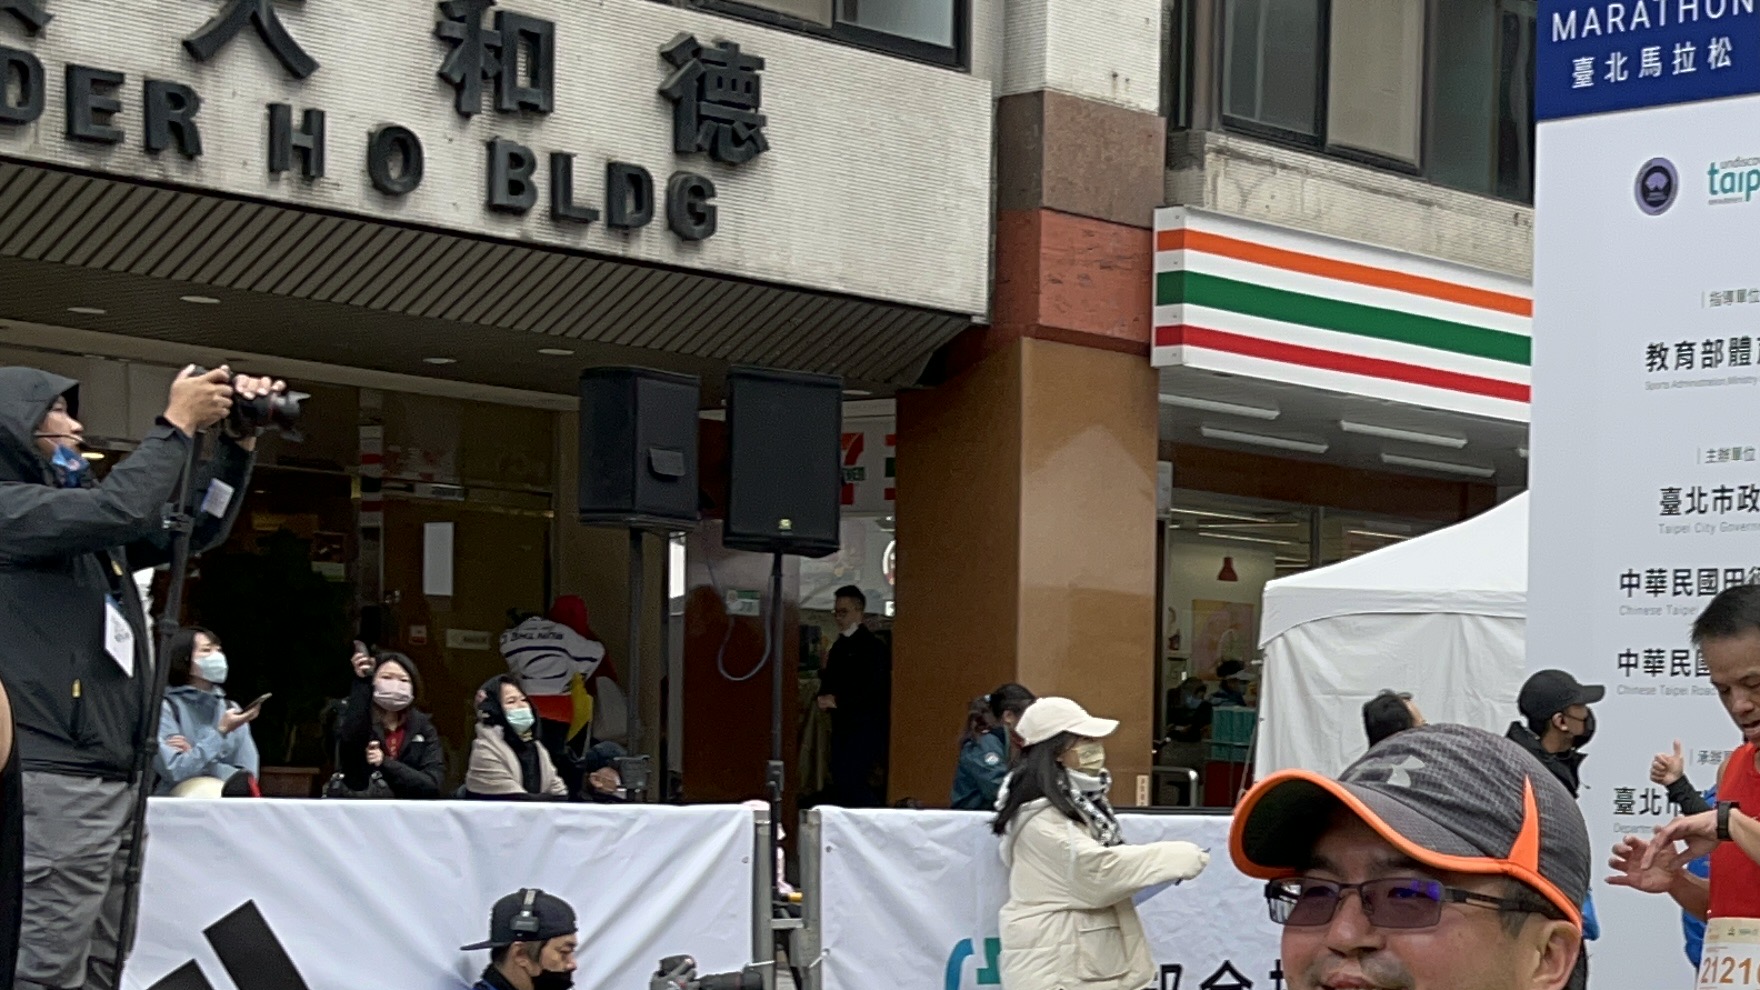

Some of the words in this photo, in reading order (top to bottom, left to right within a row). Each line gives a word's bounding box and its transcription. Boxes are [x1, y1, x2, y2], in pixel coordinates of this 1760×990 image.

[1571, 36, 1733, 89] 臺北馬拉松
[267, 102, 425, 197] HO
[486, 136, 718, 242] BLDG
[1659, 523, 1691, 535] Taipei
[1694, 521, 1716, 535] City
[1619, 605, 1663, 617] Chinese
[1666, 604, 1698, 617] Taipe
